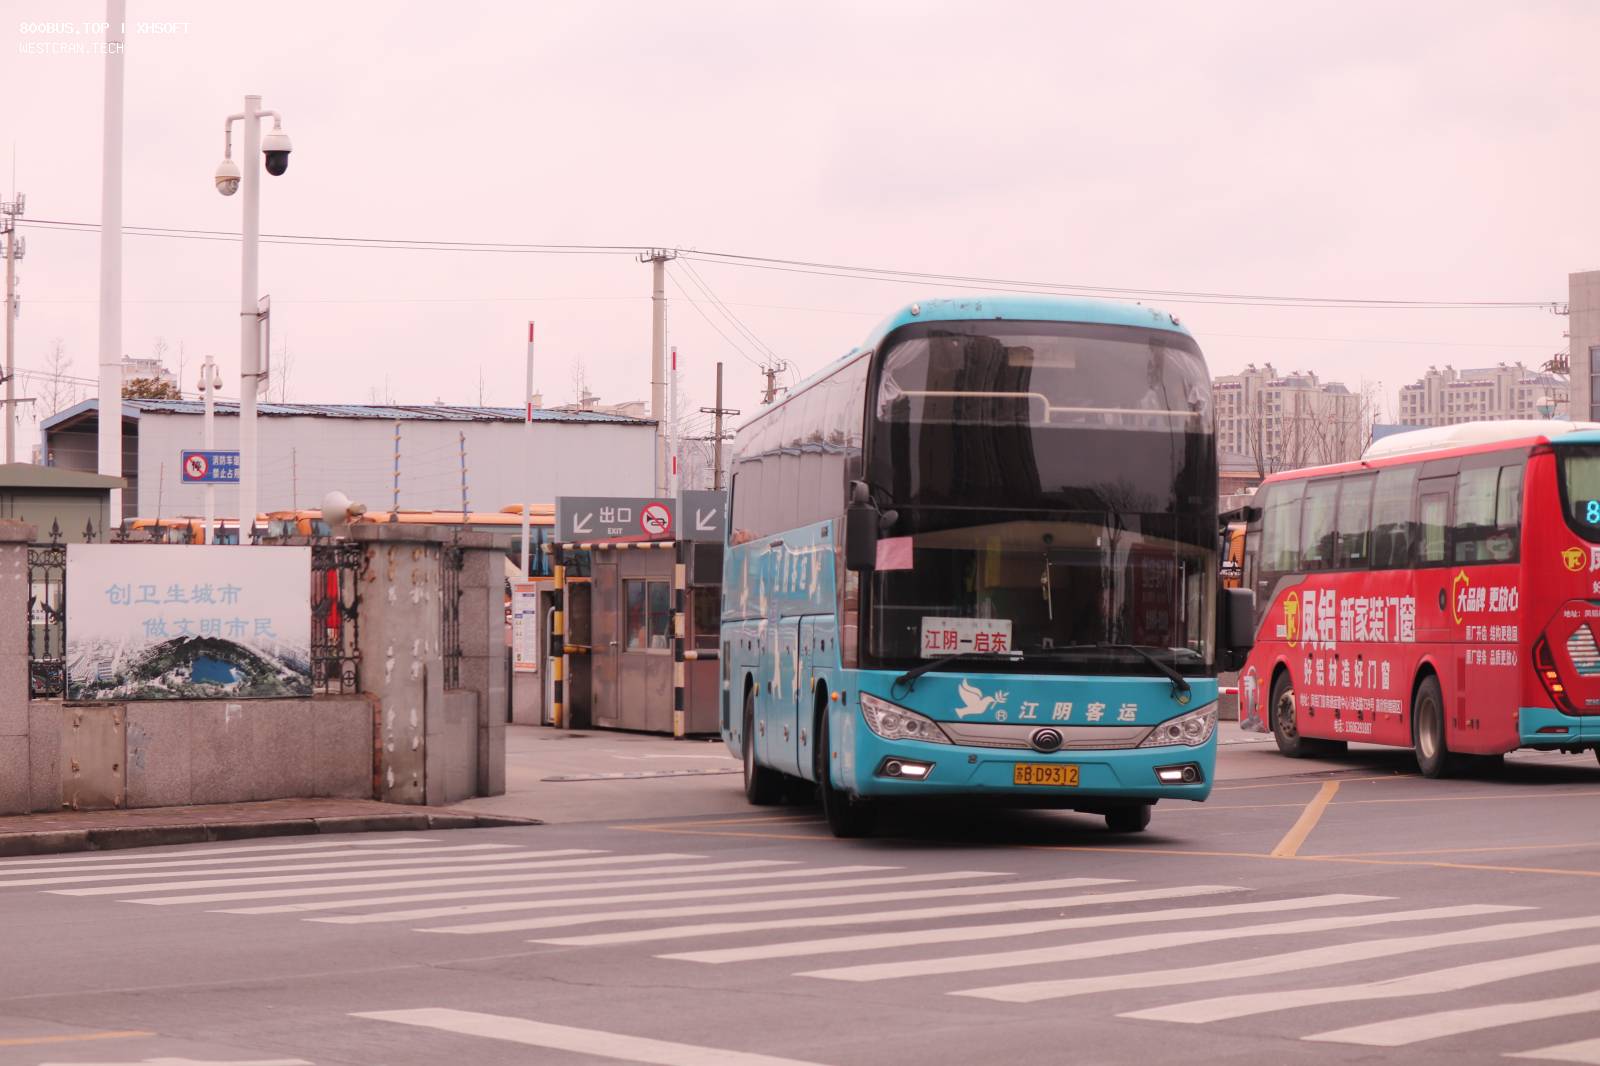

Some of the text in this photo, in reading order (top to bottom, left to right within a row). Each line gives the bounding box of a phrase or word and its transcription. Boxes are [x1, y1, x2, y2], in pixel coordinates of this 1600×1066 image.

[599, 507, 632, 523] 出口
[105, 583, 243, 606] 创卫生城市
[1457, 586, 1519, 612] 大品牌 更放心
[143, 617, 277, 638] 做文明市民
[1302, 588, 1415, 650] 凤铝 新家装门窗
[1018, 701, 1138, 721] 江阴客运
